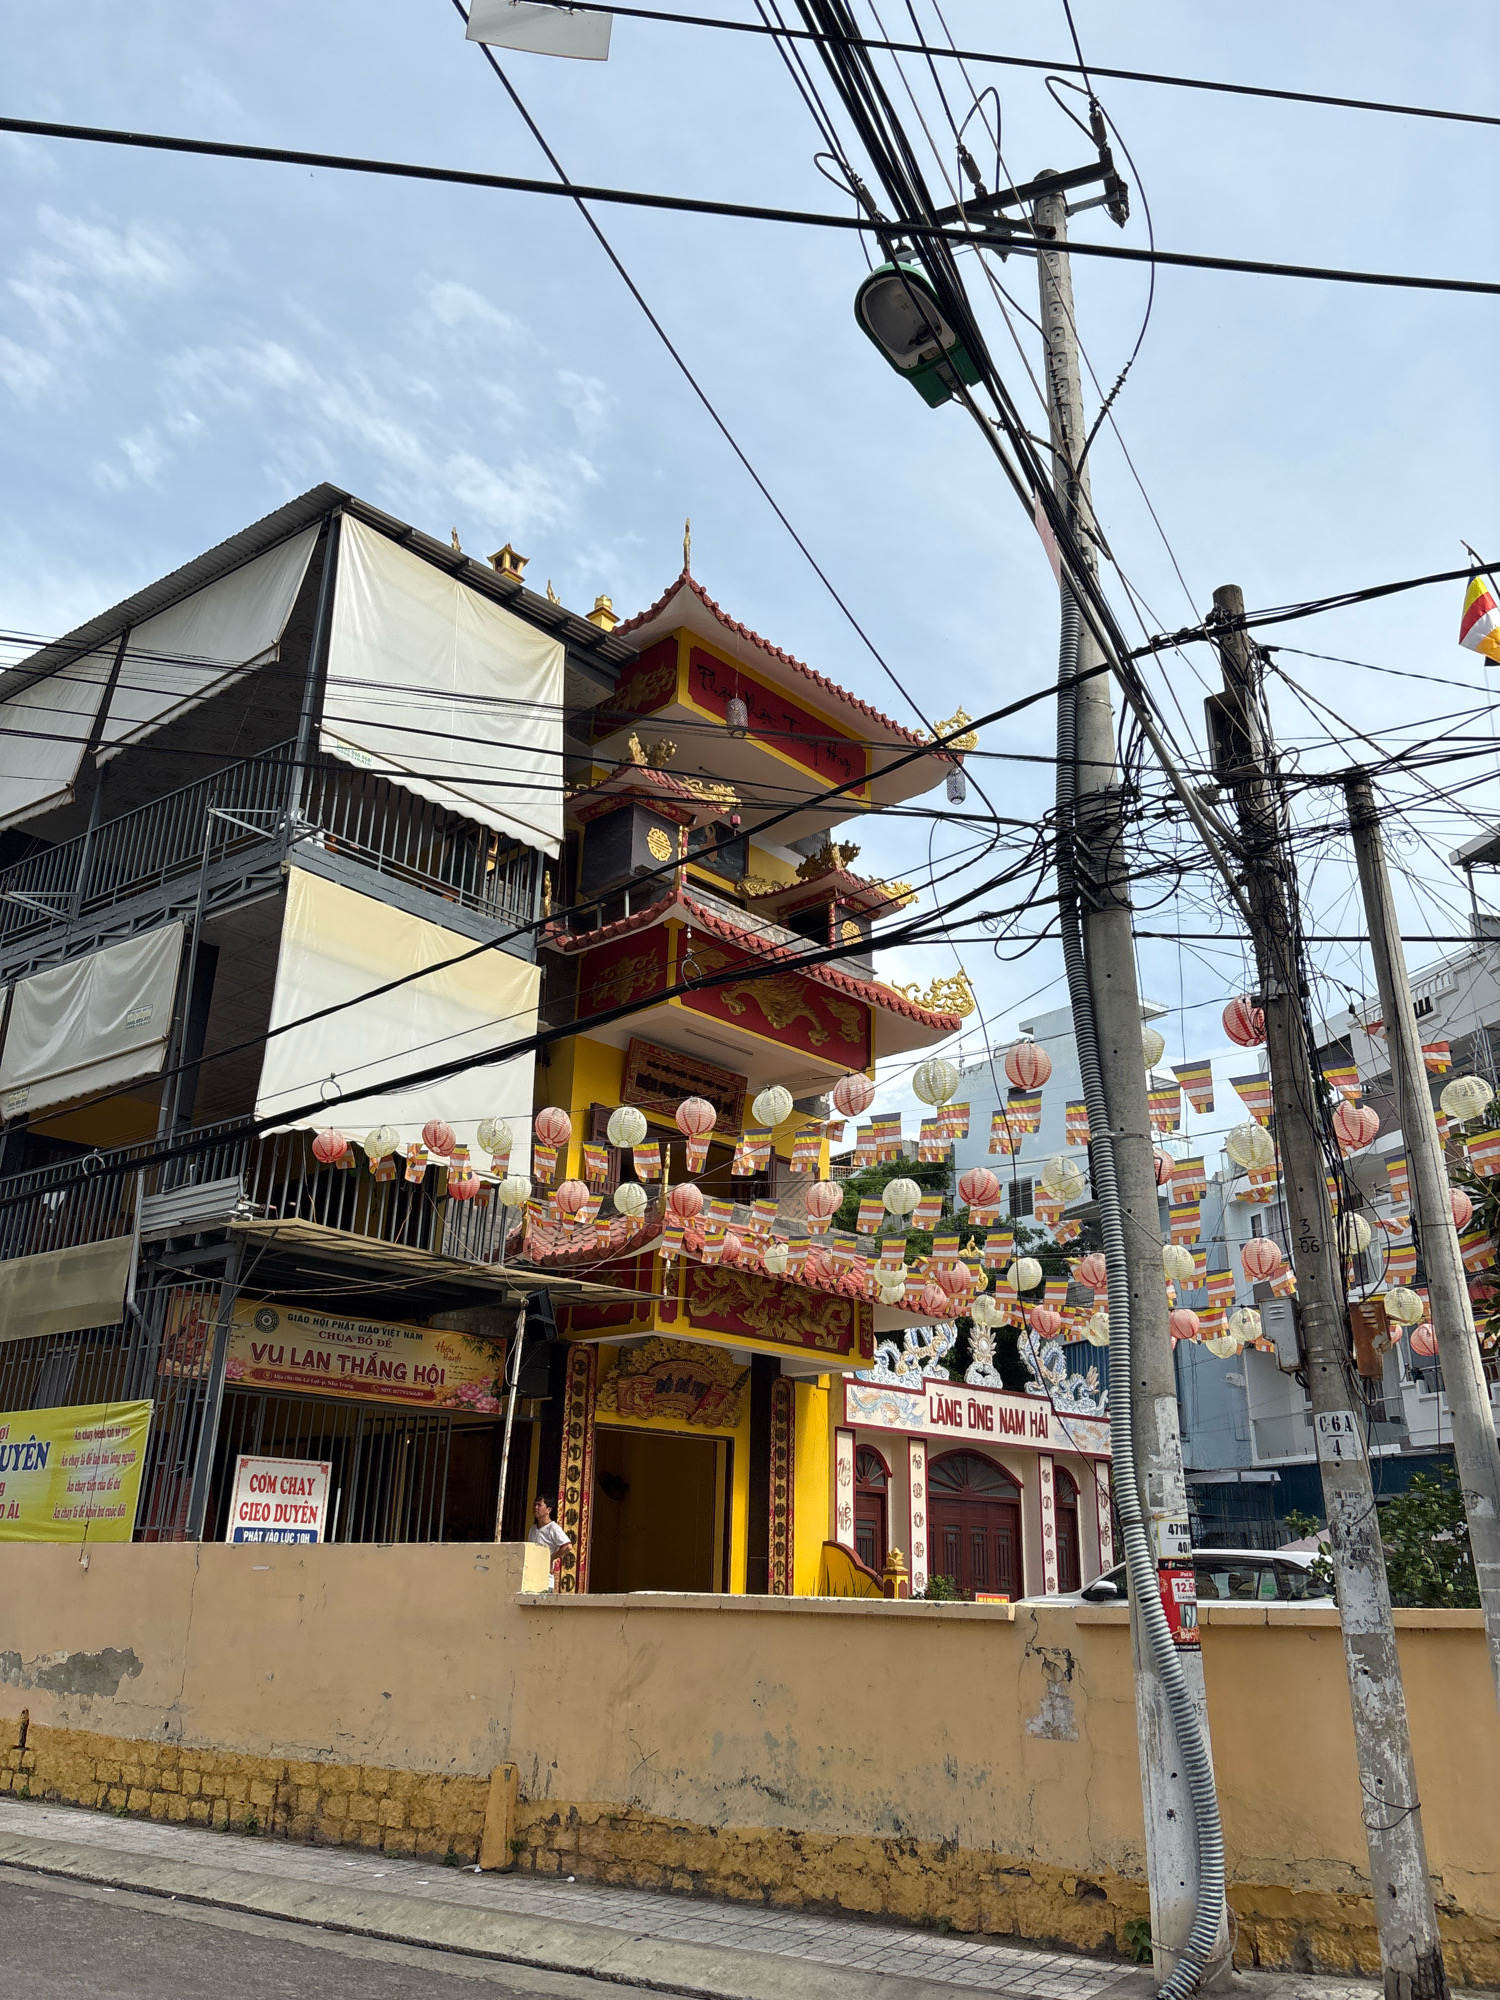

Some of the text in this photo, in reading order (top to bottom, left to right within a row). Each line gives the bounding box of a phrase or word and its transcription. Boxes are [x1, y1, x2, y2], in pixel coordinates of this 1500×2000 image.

[1300, 1239, 1320, 1253] 06
[287, 1312, 424, 1341] GIÁO HỘI PHẬT GIÁO VIỆT NAM
[318, 1329, 353, 1344] CHÙA
[251, 1342, 285, 1365] VU
[289, 1347, 332, 1372] LAN
[337, 1352, 407, 1382] THẮNG
[413, 1363, 446, 1389] HỘI
[929, 1391, 1049, 1438] LĂNG ÔNG NAM HẢI
[0, 1434, 51, 1472] UYÊN
[1333, 1439, 1342, 1456] 4
[249, 1471, 316, 1496] CƠM CHAY
[239, 1499, 319, 1524] GIEO DUYÊN
[243, 1529, 263, 1542] PHÁT
[280, 1530, 295, 1543] LÚC
[296, 1533, 311, 1544] 10H
